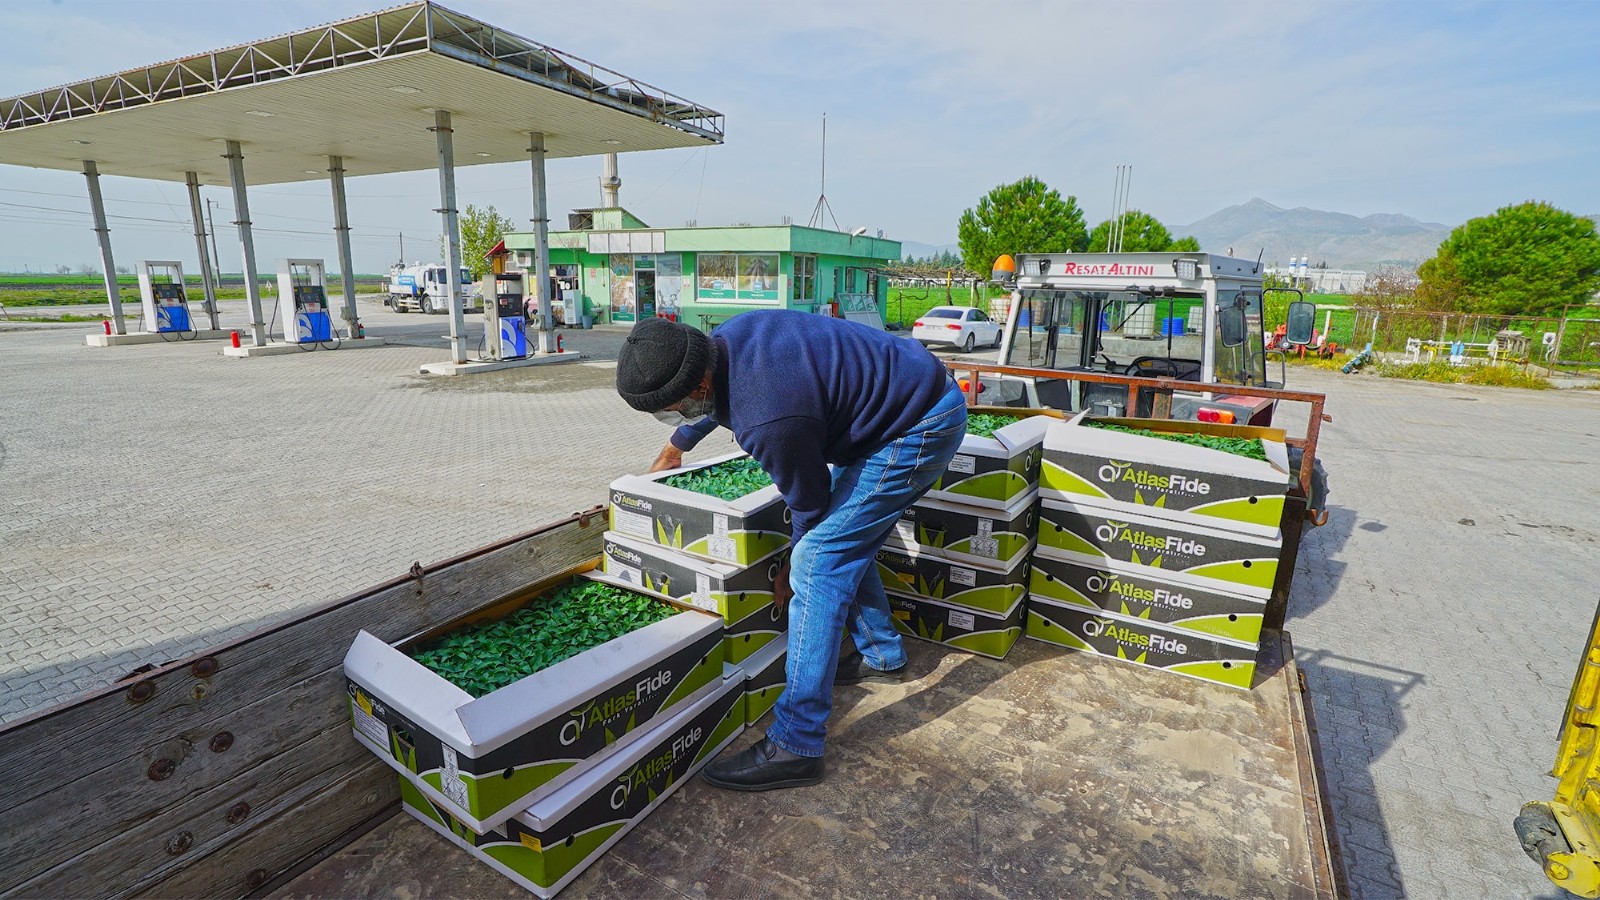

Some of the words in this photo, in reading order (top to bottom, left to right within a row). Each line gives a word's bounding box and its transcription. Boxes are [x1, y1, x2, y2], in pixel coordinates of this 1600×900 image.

[1107, 263, 1154, 276] ALTINI
[1122, 468, 1211, 495] AtlasFide
[621, 496, 653, 510] AtlasFide
[1119, 528, 1206, 556] AtlasFide
[1109, 580, 1193, 609] AtlasFide
[1104, 625, 1188, 655] AtlasFide
[587, 670, 672, 729] AtlasFide
[634, 727, 702, 791] AtlasFide
